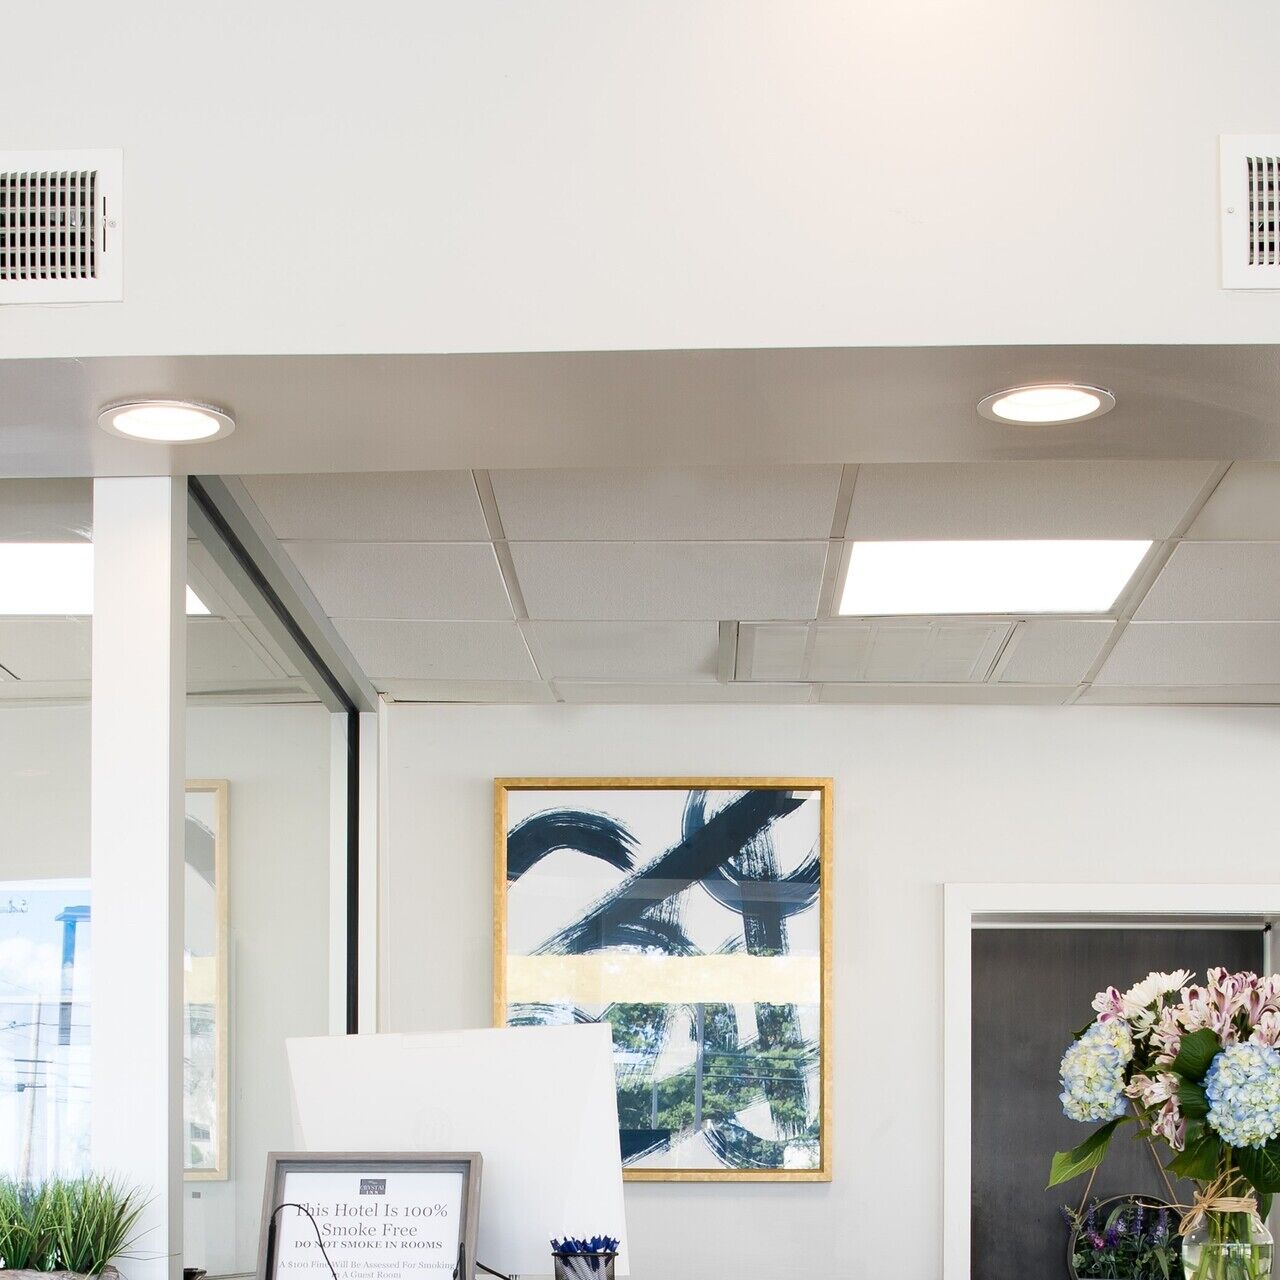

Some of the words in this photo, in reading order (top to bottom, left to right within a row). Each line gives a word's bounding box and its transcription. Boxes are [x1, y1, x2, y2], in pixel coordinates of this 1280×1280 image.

[296, 1203, 329, 1217] This
[335, 1203, 378, 1217] Hotel
[385, 1203, 399, 1217] Is
[404, 1203, 448, 1217] 100%
[321, 1222, 377, 1237] Smoke
[383, 1223, 418, 1237] Free
[295, 1241, 311, 1249] DO
[315, 1241, 336, 1249] NOT
[340, 1241, 382, 1249] SMOKE
[385, 1241, 398, 1249] IN
[401, 1241, 443, 1249] ROOMS
[279, 1261, 286, 1269] A
[287, 1261, 309, 1269] $100
[331, 1261, 349, 1269] Will
[351, 1261, 360, 1269] Be
[364, 1261, 400, 1269] Assessed
[402, 1261, 417, 1269] For
[418, 1261, 455, 1271] Smoking
[342, 1271, 349, 1279] A
[350, 1271, 374, 1279] Guest
[377, 1271, 401, 1279] Room
